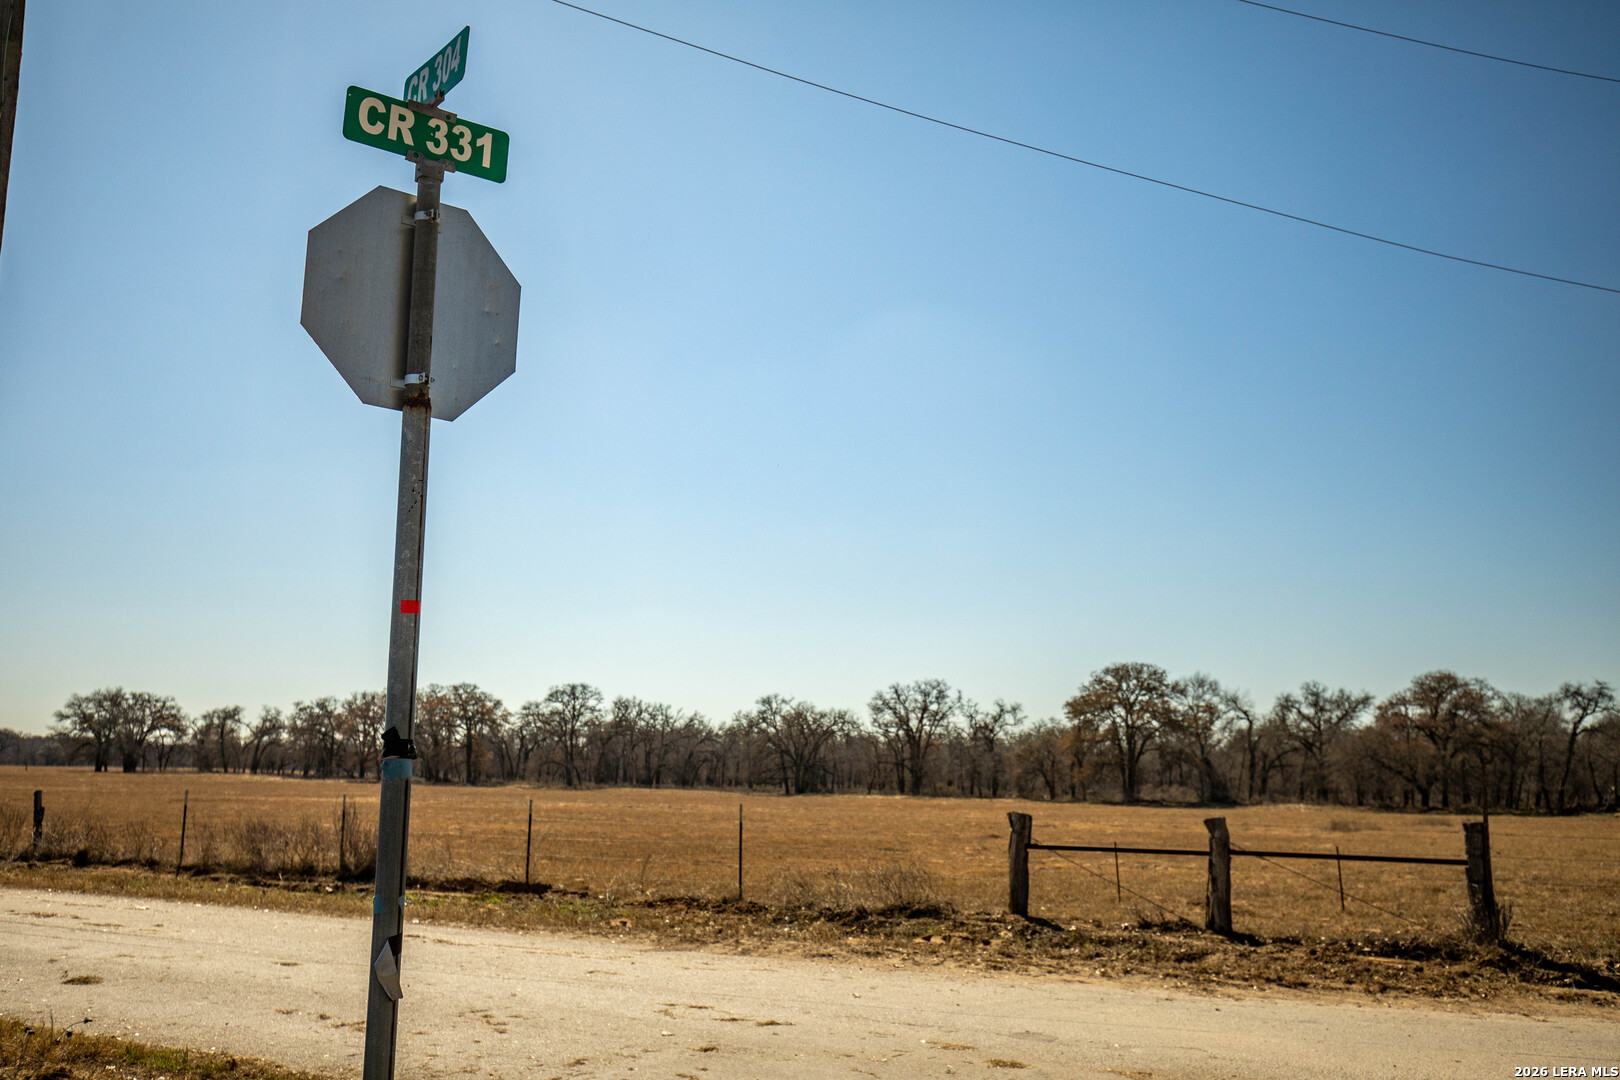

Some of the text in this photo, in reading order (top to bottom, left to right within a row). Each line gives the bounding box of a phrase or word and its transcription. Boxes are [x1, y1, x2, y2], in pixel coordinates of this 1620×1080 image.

[407, 35, 462, 103] CR 304
[358, 97, 493, 168] CR 331
